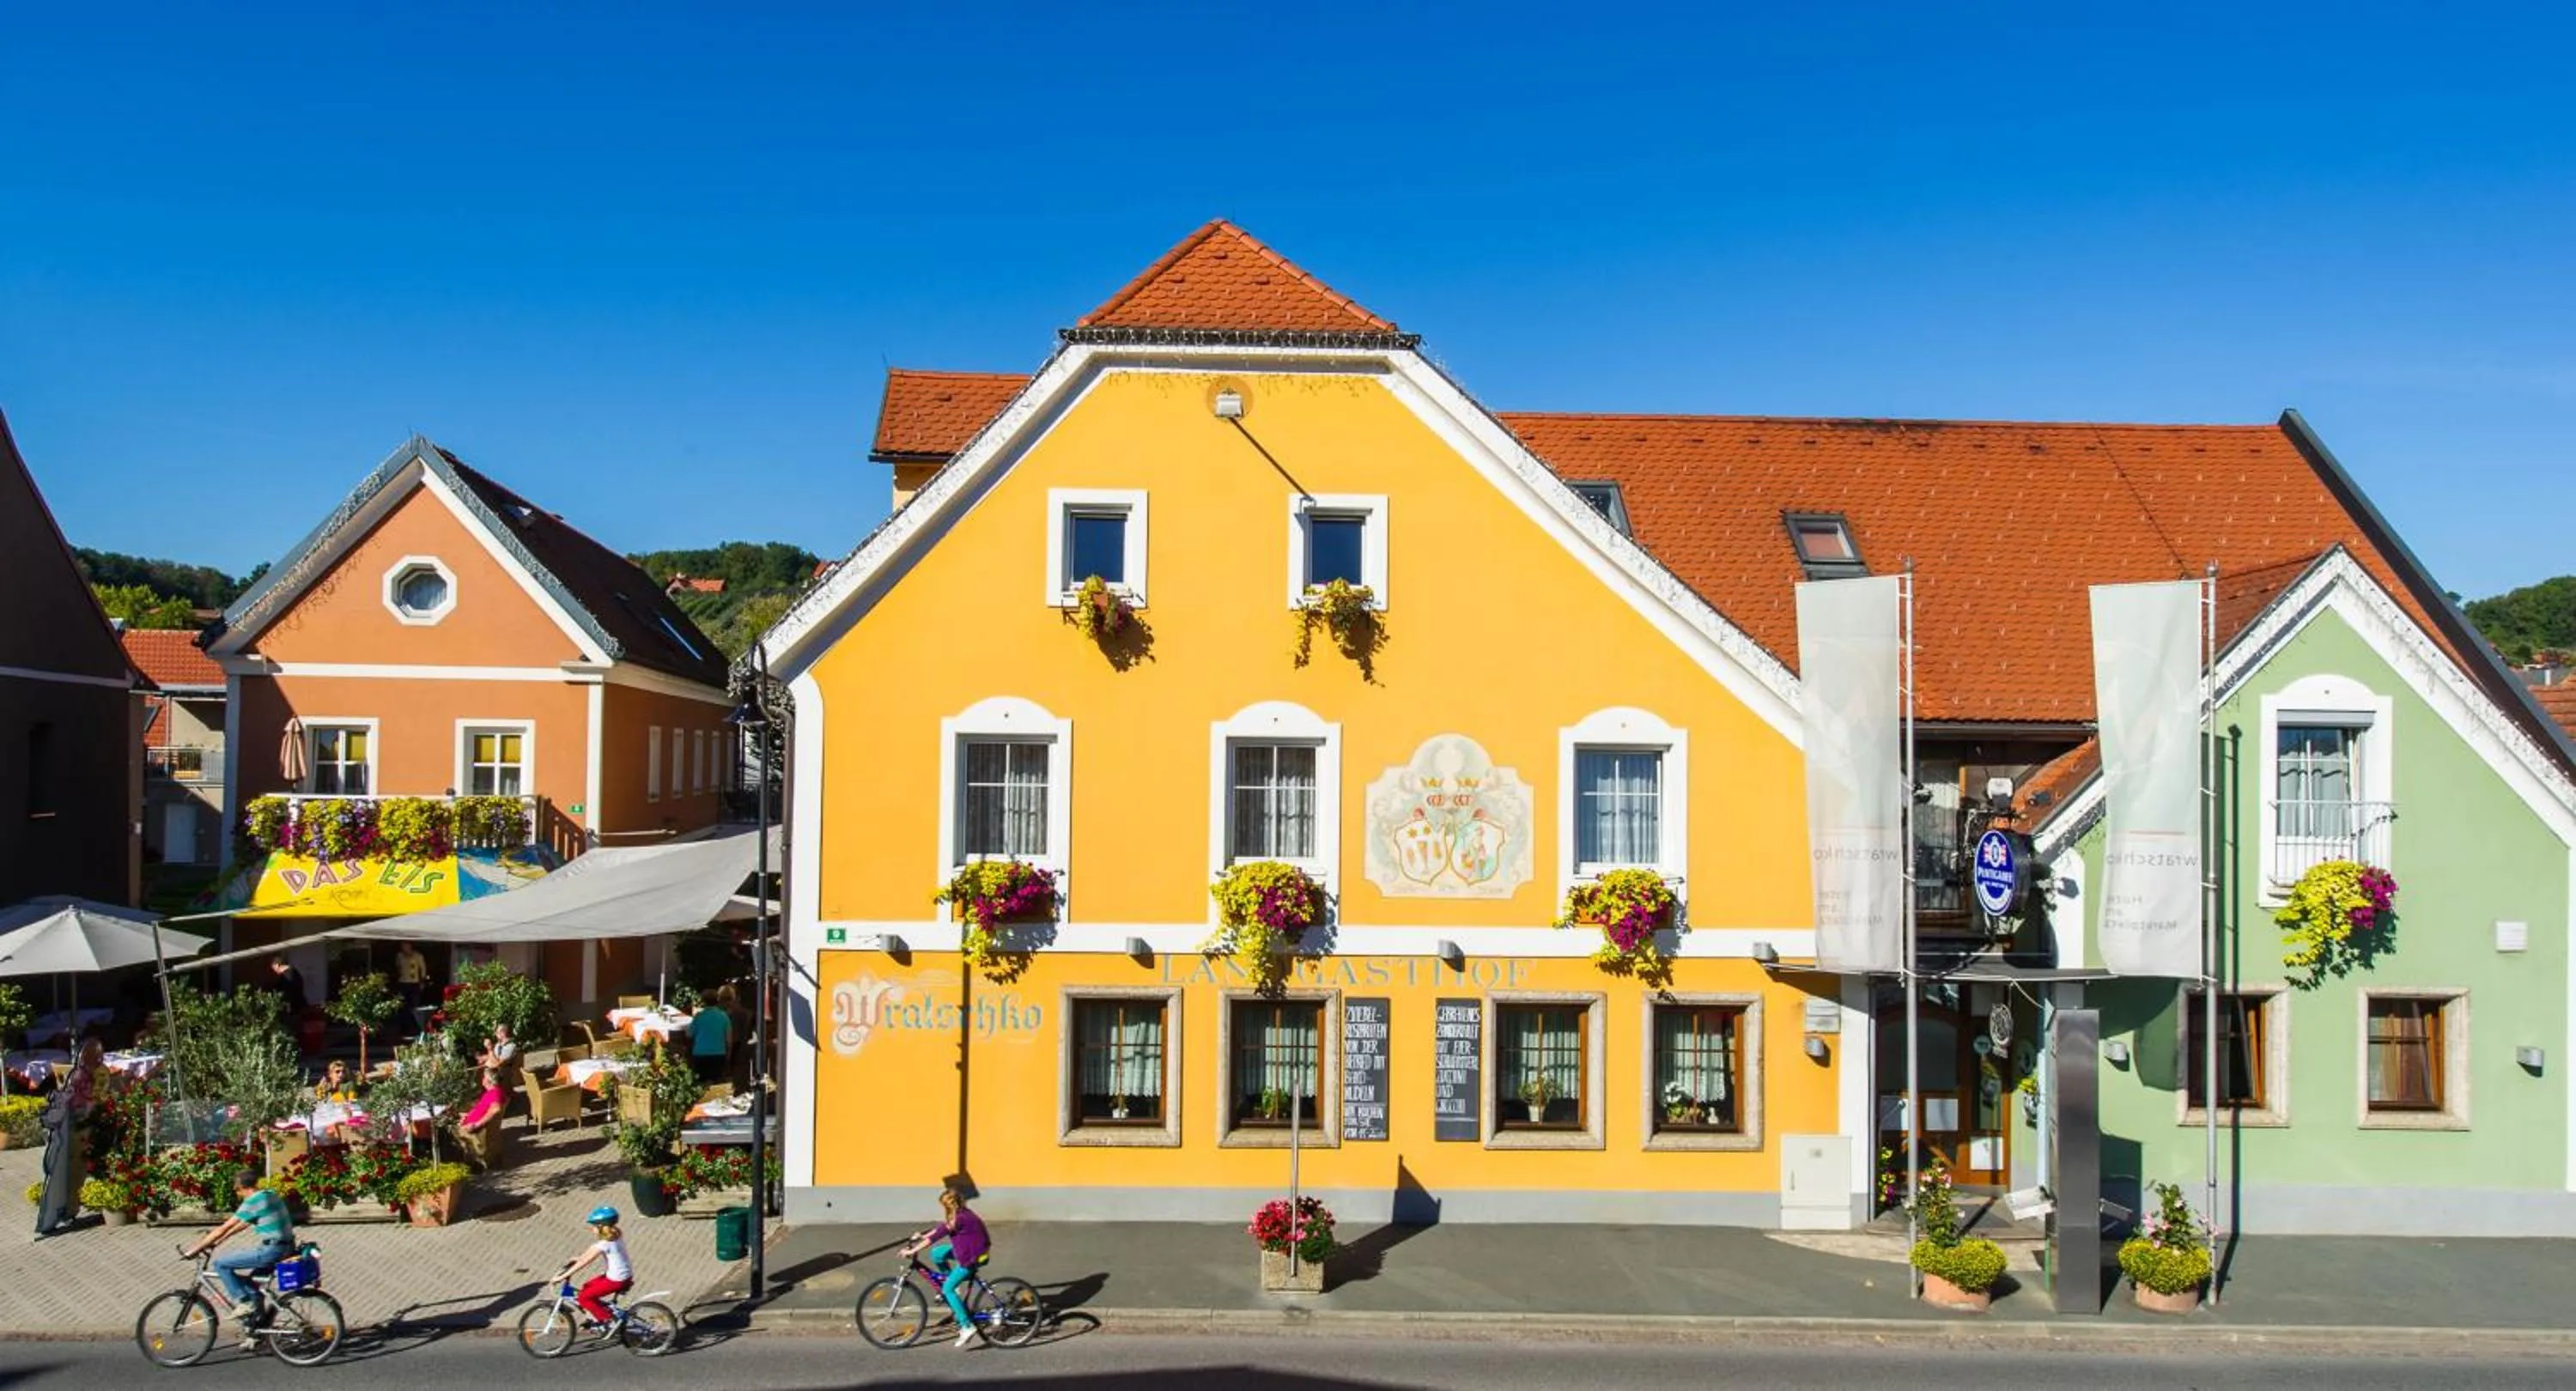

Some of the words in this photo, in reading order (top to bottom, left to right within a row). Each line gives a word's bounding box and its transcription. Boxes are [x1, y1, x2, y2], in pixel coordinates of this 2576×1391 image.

[280, 860, 363, 894] DAS
[379, 858, 445, 894] EIS
[832, 973, 1042, 1054] Wratschko
